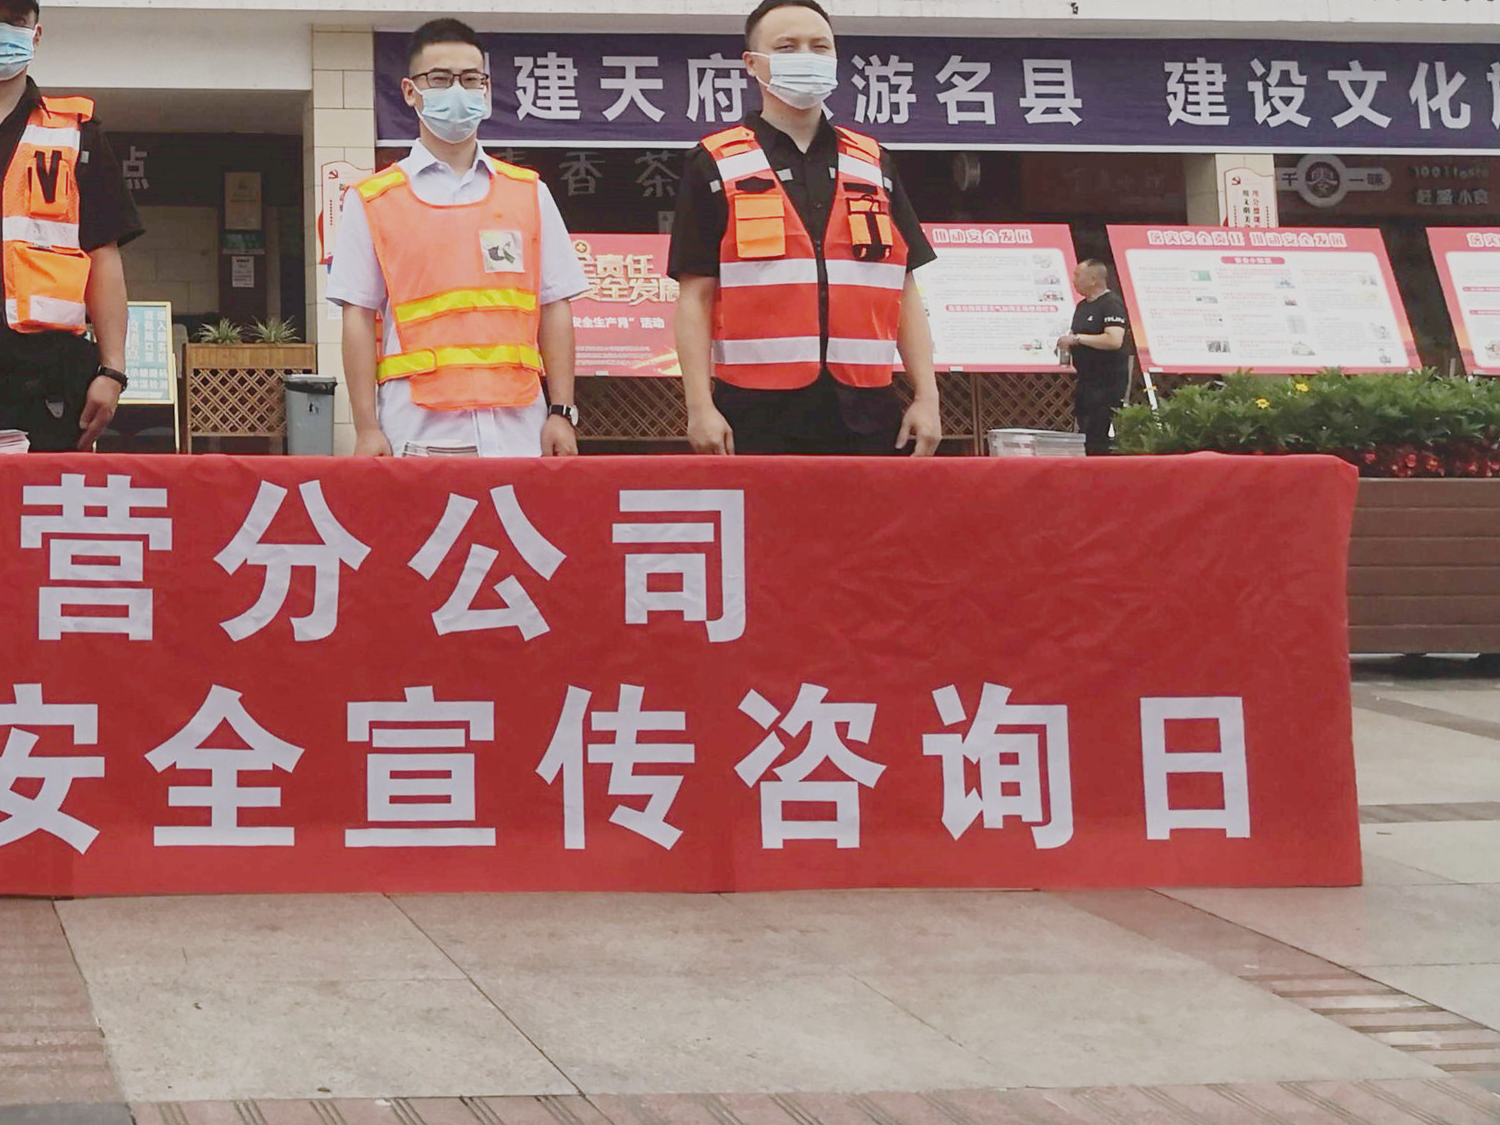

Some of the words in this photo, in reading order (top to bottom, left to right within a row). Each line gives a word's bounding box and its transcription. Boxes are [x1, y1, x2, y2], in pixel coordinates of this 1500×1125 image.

[482, 51, 1083, 127] 建天府游名县
[1164, 57, 1500, 130] 建设文化
